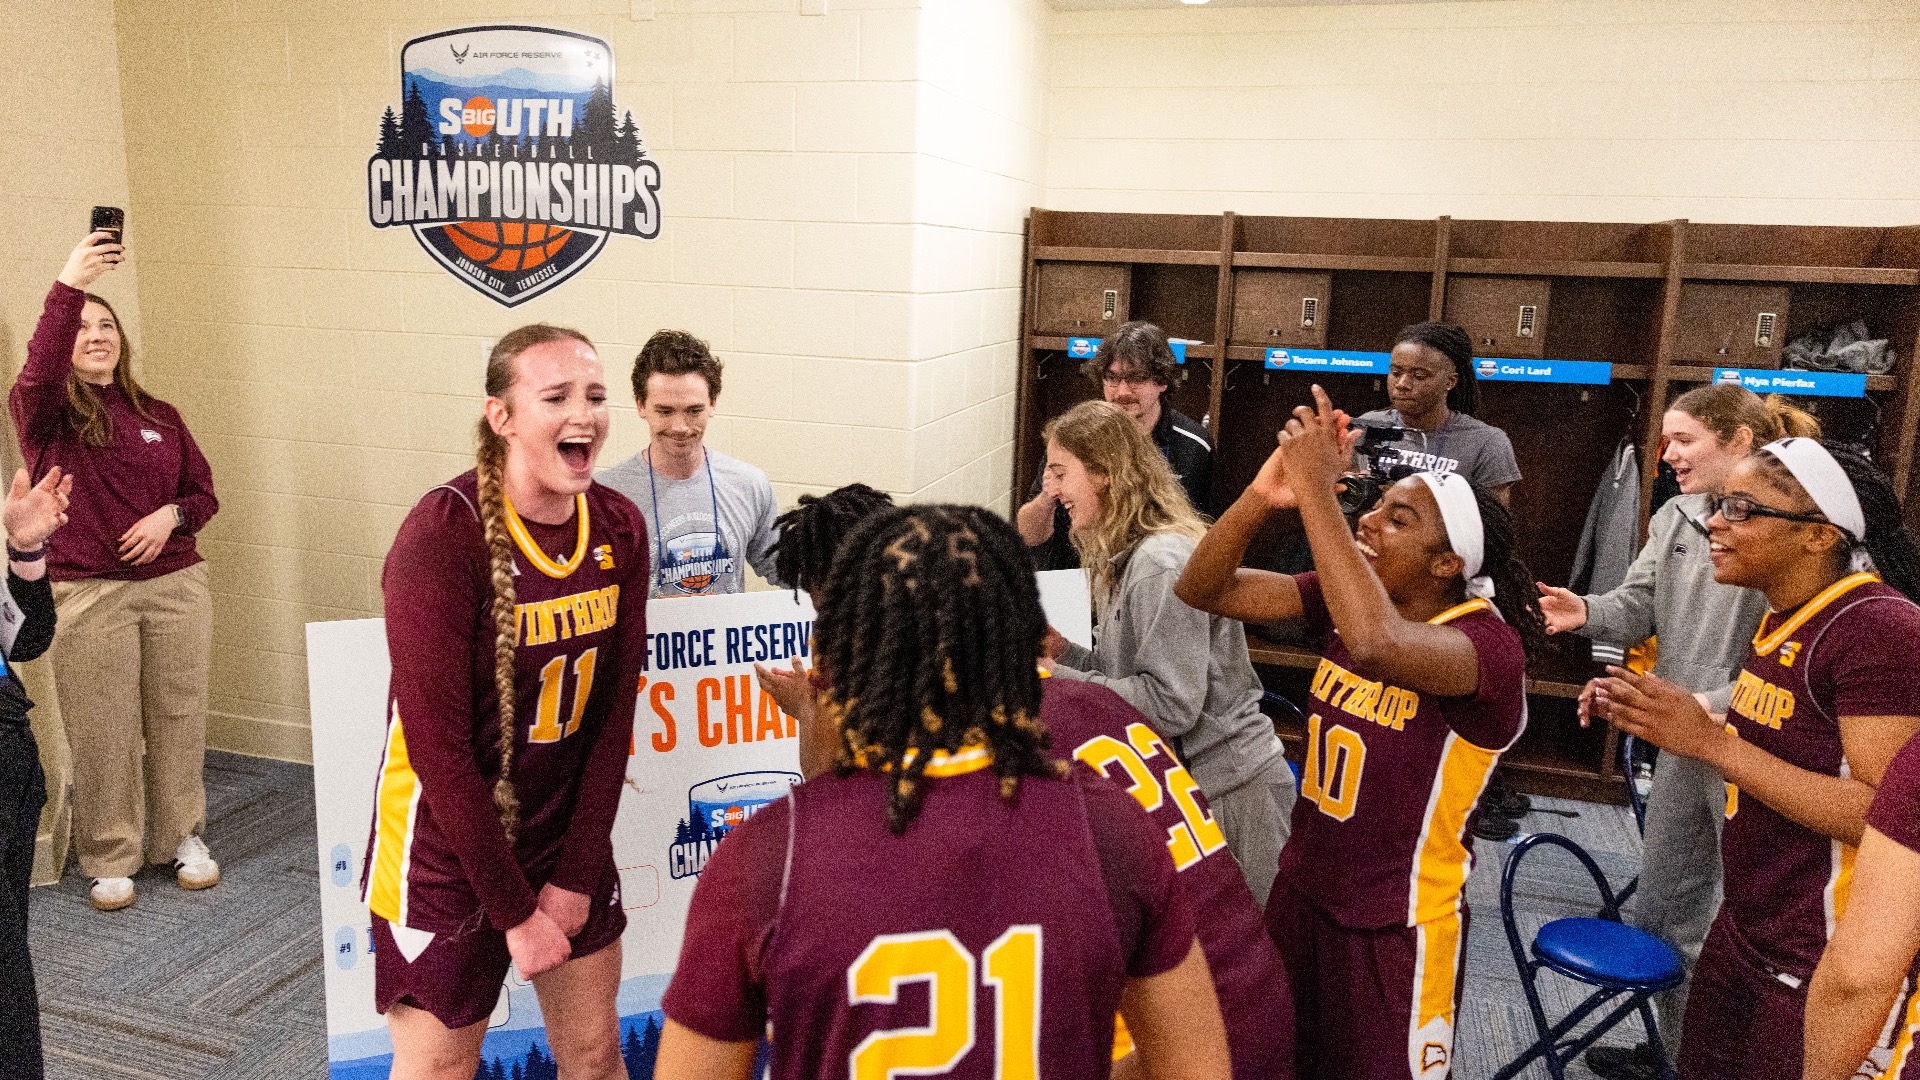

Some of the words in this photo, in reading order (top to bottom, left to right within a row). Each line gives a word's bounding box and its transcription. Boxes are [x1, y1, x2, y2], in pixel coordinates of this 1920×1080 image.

[521, 51, 564, 59] RESERVE
[462, 108, 496, 126] BIG
[423, 142, 593, 160] BASKETBALL
[370, 158, 657, 235] CHAMPIONSHIPS
[456, 256, 487, 281] JOHNSON
[487, 276, 505, 292] CITY
[516, 263, 558, 291] TENNESSEE
[1291, 355, 1328, 365] Tocarra
[1330, 357, 1374, 367] Johnson
[1501, 365, 1525, 375] Cori
[1527, 366, 1552, 376] Lard
[1744, 376, 1769, 388] Mya
[1772, 377, 1816, 388] Pierfax
[643, 628, 716, 672] FORCE
[725, 620, 816, 665] RESERV
[527, 647, 598, 744] 11
[696, 673, 798, 748] CHA
[1301, 713, 1367, 822] 10
[1072, 722, 1228, 873] 22
[339, 942, 351, 954] #9
[848, 924, 1042, 1080] 21
